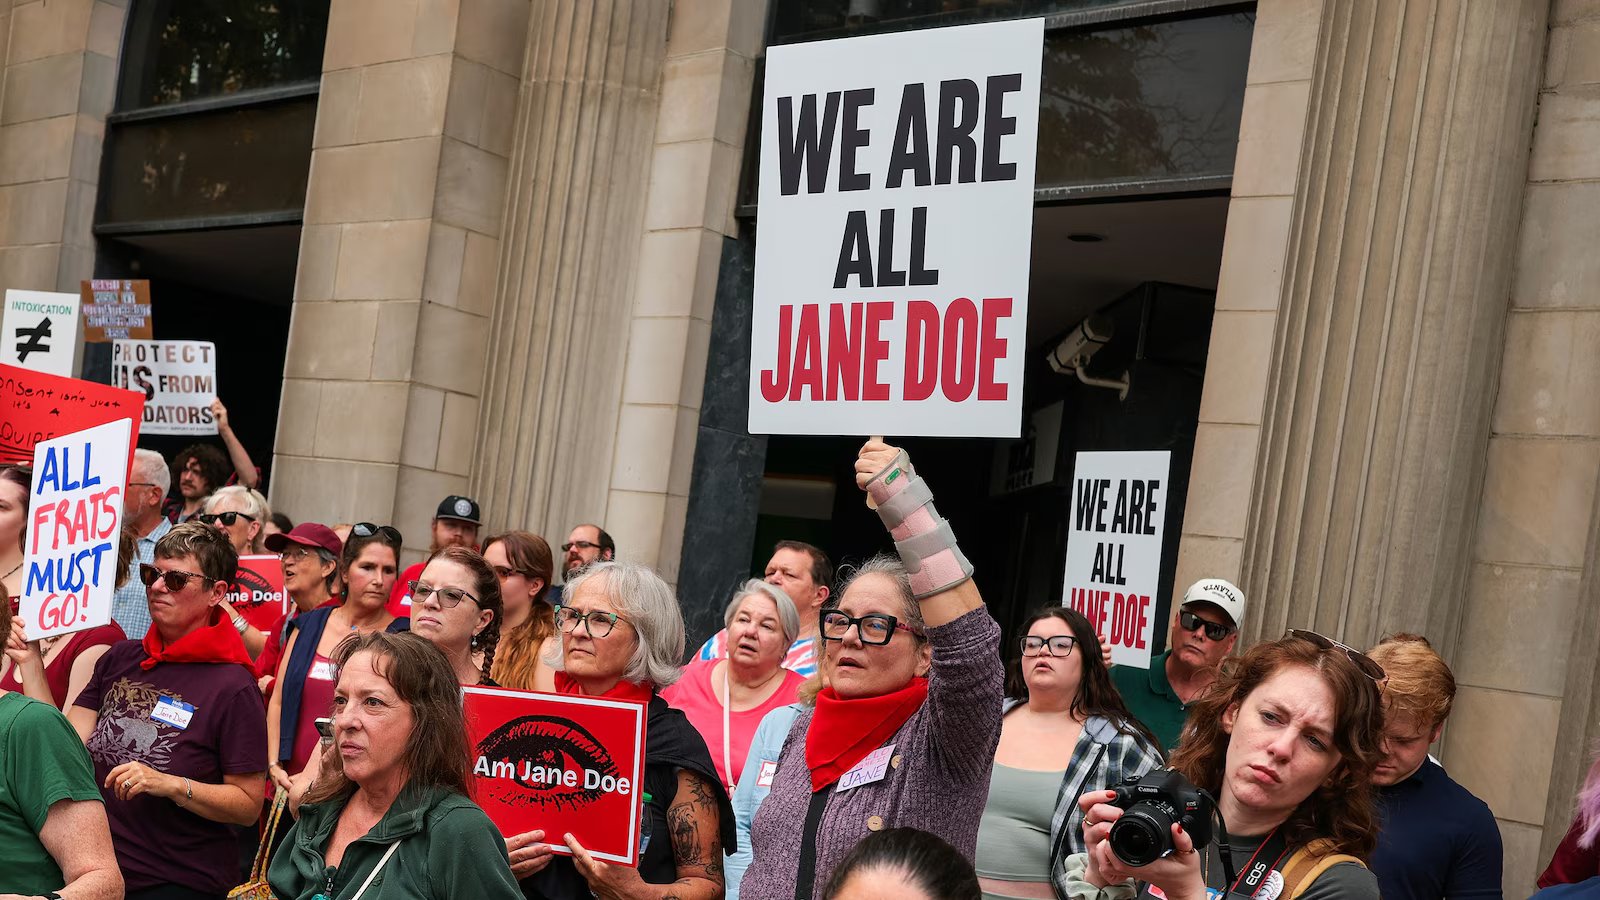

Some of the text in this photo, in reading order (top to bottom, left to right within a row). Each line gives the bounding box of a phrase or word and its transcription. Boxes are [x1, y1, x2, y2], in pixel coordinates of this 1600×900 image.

[776, 73, 1022, 196] WE ARE
[832, 206, 939, 289] ALL
[12, 301, 72, 315] INTOXICATION
[114, 343, 211, 364] PROTECT
[760, 297, 1013, 403] JANE DOE
[0, 376, 54, 399] onsent
[60, 390, 86, 402] isn't
[159, 374, 213, 393] FROM
[142, 405, 213, 424] DATORS
[36, 442, 101, 495] ALL
[31, 486, 120, 555] FRATS
[1076, 478, 1160, 535] WE ARE
[25, 542, 113, 597] MUST
[1090, 542, 1127, 586] ALL
[38, 584, 90, 631] GO!
[224, 590, 282, 602] ane Doe
[1203, 584, 1236, 603] ATLANTA
[1110, 592, 1150, 650] DOE
[473, 755, 631, 795] Am Jane Doe
[842, 763, 886, 787] JANE
[1245, 862, 1267, 886] EOS
